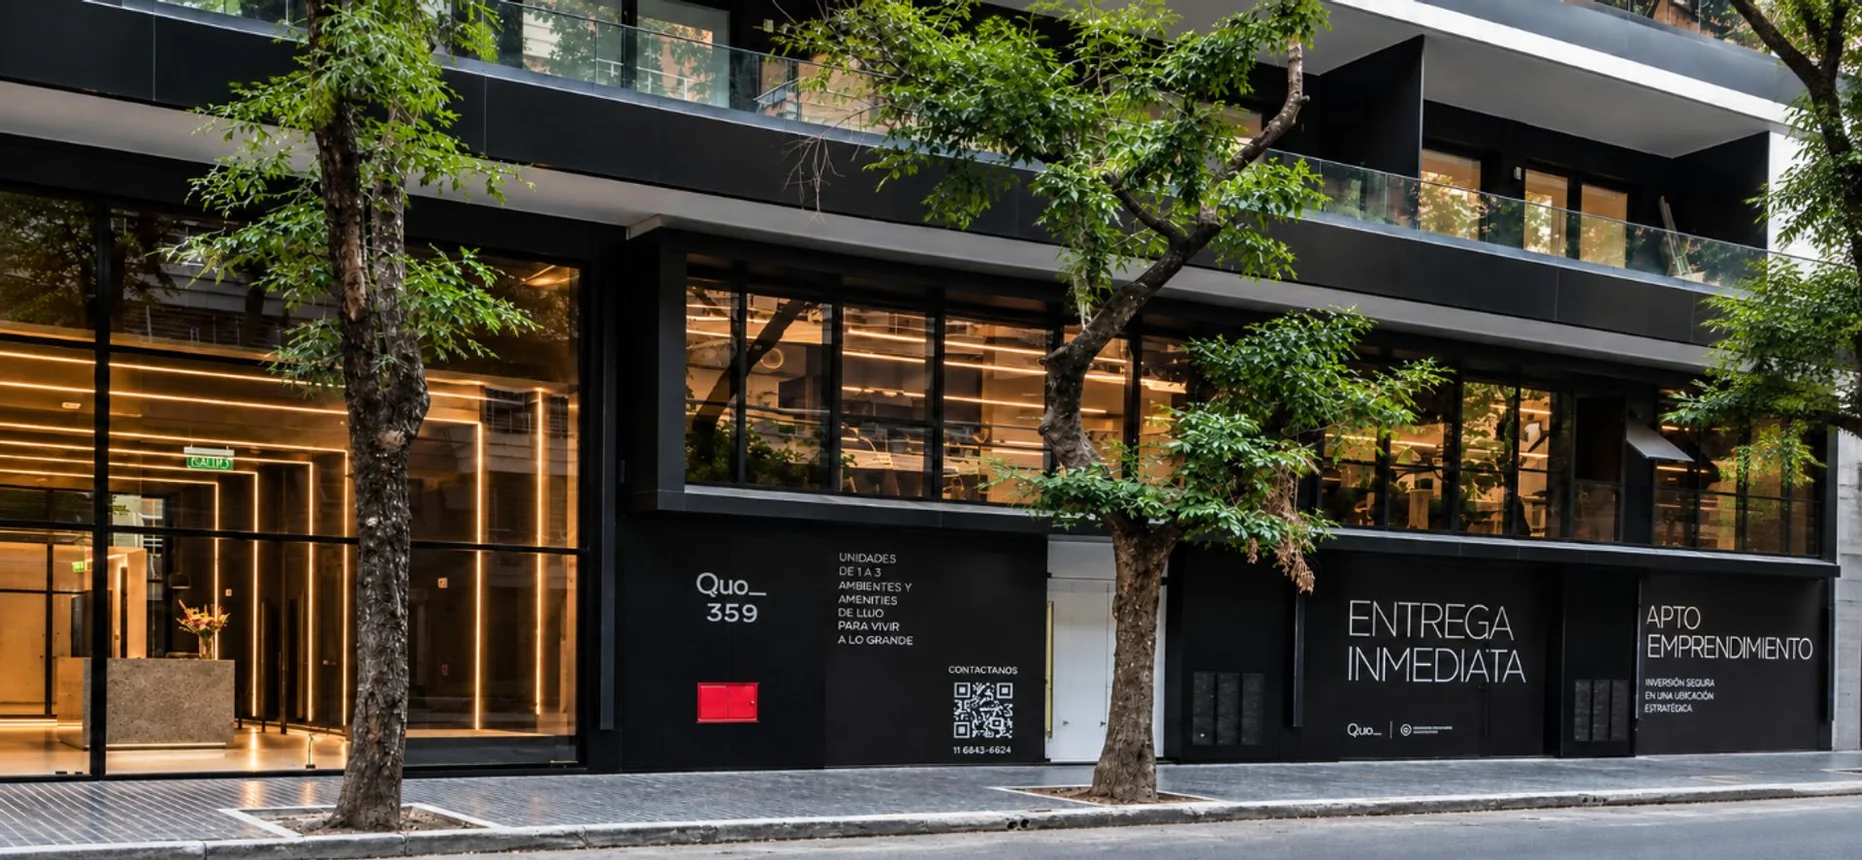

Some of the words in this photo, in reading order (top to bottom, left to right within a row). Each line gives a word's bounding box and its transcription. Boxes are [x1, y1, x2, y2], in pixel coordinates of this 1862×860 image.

[839, 553, 897, 565] UNIDADES
[838, 566, 855, 577] DE
[857, 567, 862, 577] 1
[863, 568, 872, 577] A
[874, 568, 882, 578] 3
[838, 581, 902, 593] AMBIENTES
[904, 583, 913, 592] Y
[838, 595, 898, 606] AMENITIES
[706, 603, 758, 622] 359
[837, 608, 854, 618] DE
[1646, 605, 1701, 630] APTO
[1348, 600, 1515, 640] ENTREGA
[837, 621, 869, 631] PARA
[870, 622, 900, 632] VIVIR
[837, 635, 847, 644] A
[848, 635, 865, 645] LO
[865, 636, 913, 646] GRANDE
[1647, 634, 1814, 660] EMPRENDIMIENTO
[1348, 646, 1527, 683] INMEDIATA
[948, 666, 1019, 676] CONTACTANOS
